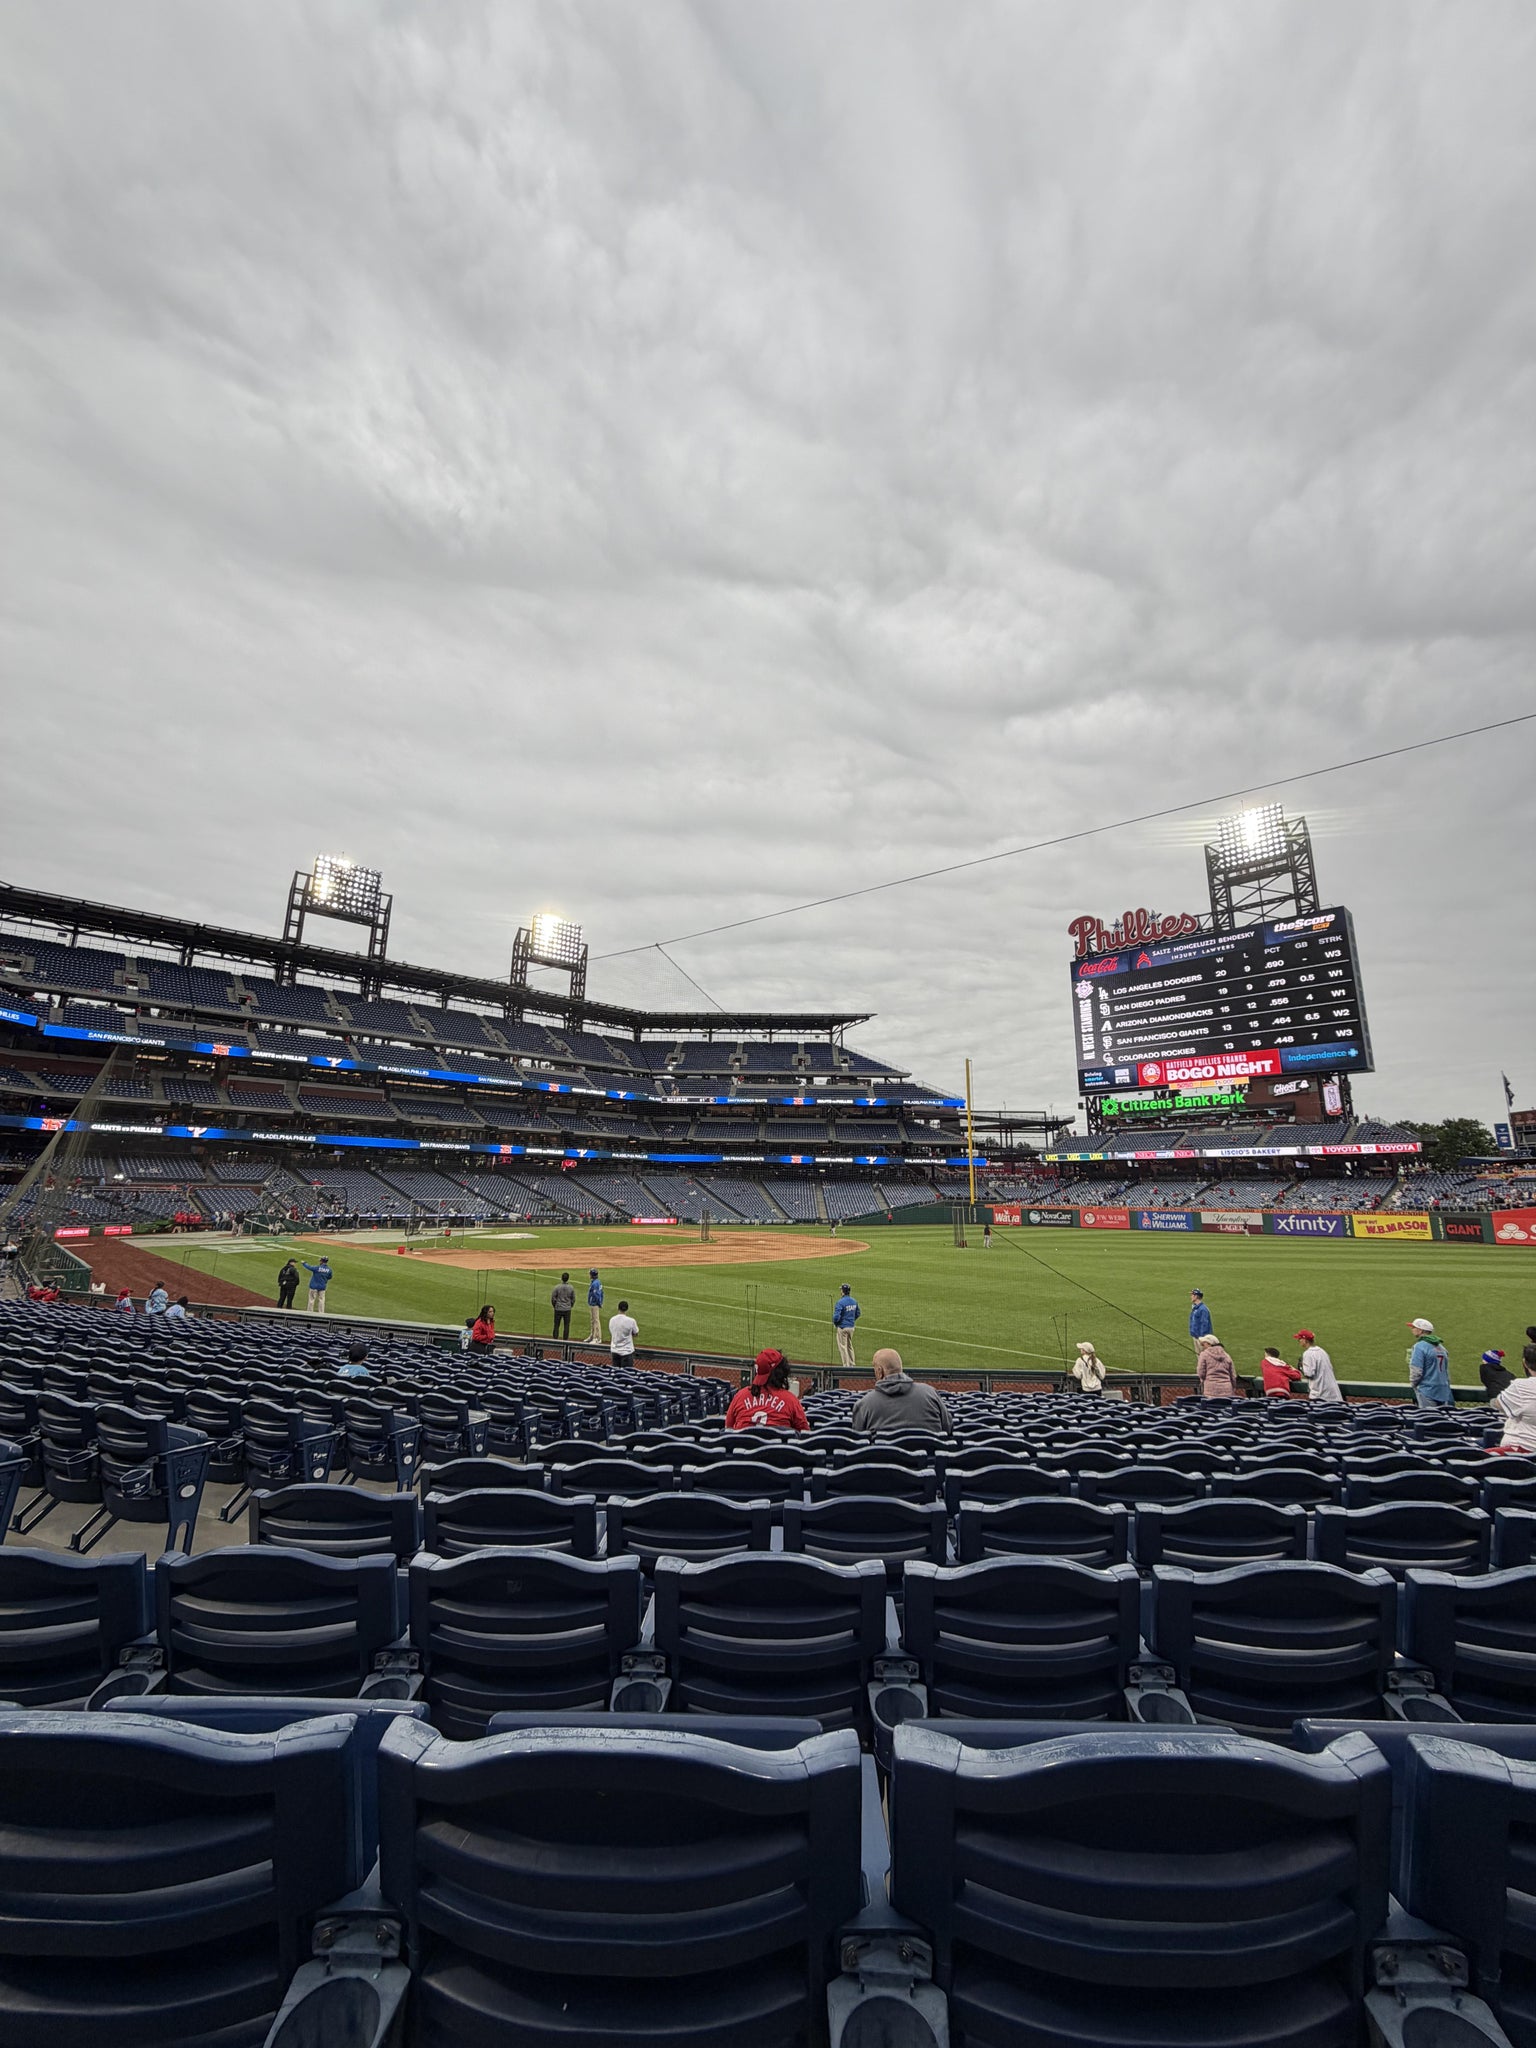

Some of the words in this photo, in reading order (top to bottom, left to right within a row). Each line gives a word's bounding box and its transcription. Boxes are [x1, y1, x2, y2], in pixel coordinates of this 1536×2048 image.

[1068, 908, 1198, 956] Phillies
[1274, 913, 1335, 933] theScore
[1202, 944, 1235, 954] LAWYERS
[1318, 935, 1343, 945] STRK
[1152, 948, 1171, 956] SALTZ
[1128, 982, 1162, 993] ANGELES
[1164, 974, 1202, 986] DODGERS
[1264, 960, 1284, 969] .690
[1324, 950, 1342, 958] W3
[1114, 1003, 1129, 1011] SAN
[1131, 1000, 1154, 1009] DIEGO
[1155, 995, 1186, 1005] PADRES
[1268, 979, 1286, 987] .679
[1328, 970, 1343, 978] W1
[1116, 1019, 1148, 1028] ARIZONA
[1150, 1009, 1214, 1023] DIAMONDBACKS
[1270, 998, 1288, 1006] .556
[1331, 989, 1346, 997] W1
[1117, 1037, 1132, 1045] SAN
[1134, 1031, 1177, 1043] FRANCISCO
[1179, 1027, 1209, 1037] GIANTS
[1272, 1016, 1291, 1025] .464
[1333, 1009, 1350, 1017] W2
[103, 1034, 141, 1044] FRANCISCO
[1118, 1051, 1160, 1062] COLORADO
[1161, 1047, 1196, 1058] ROCKIES
[1274, 1036, 1294, 1044] .448
[1288, 1050, 1347, 1062] Independence
[1166, 1061, 1193, 1072] HATFIELD
[1194, 1057, 1221, 1070] PHILLIES
[1167, 1066, 1215, 1081] BOGO
[1217, 1060, 1273, 1077] NIGHT
[1121, 1098, 1172, 1112] Citizens
[1175, 1096, 1210, 1108] Bank
[1212, 1091, 1245, 1105] Park
[91, 1124, 121, 1132] GIANTS
[130, 1125, 163, 1134] PHILLIES
[1152, 1213, 1186, 1221] SHERWIN
[1277, 1215, 1337, 1233] xfinity
[1446, 1224, 1481, 1235] GIANT
[1437, 1354, 1443, 1372] 7
[744, 1393, 785, 1412] HARPER
